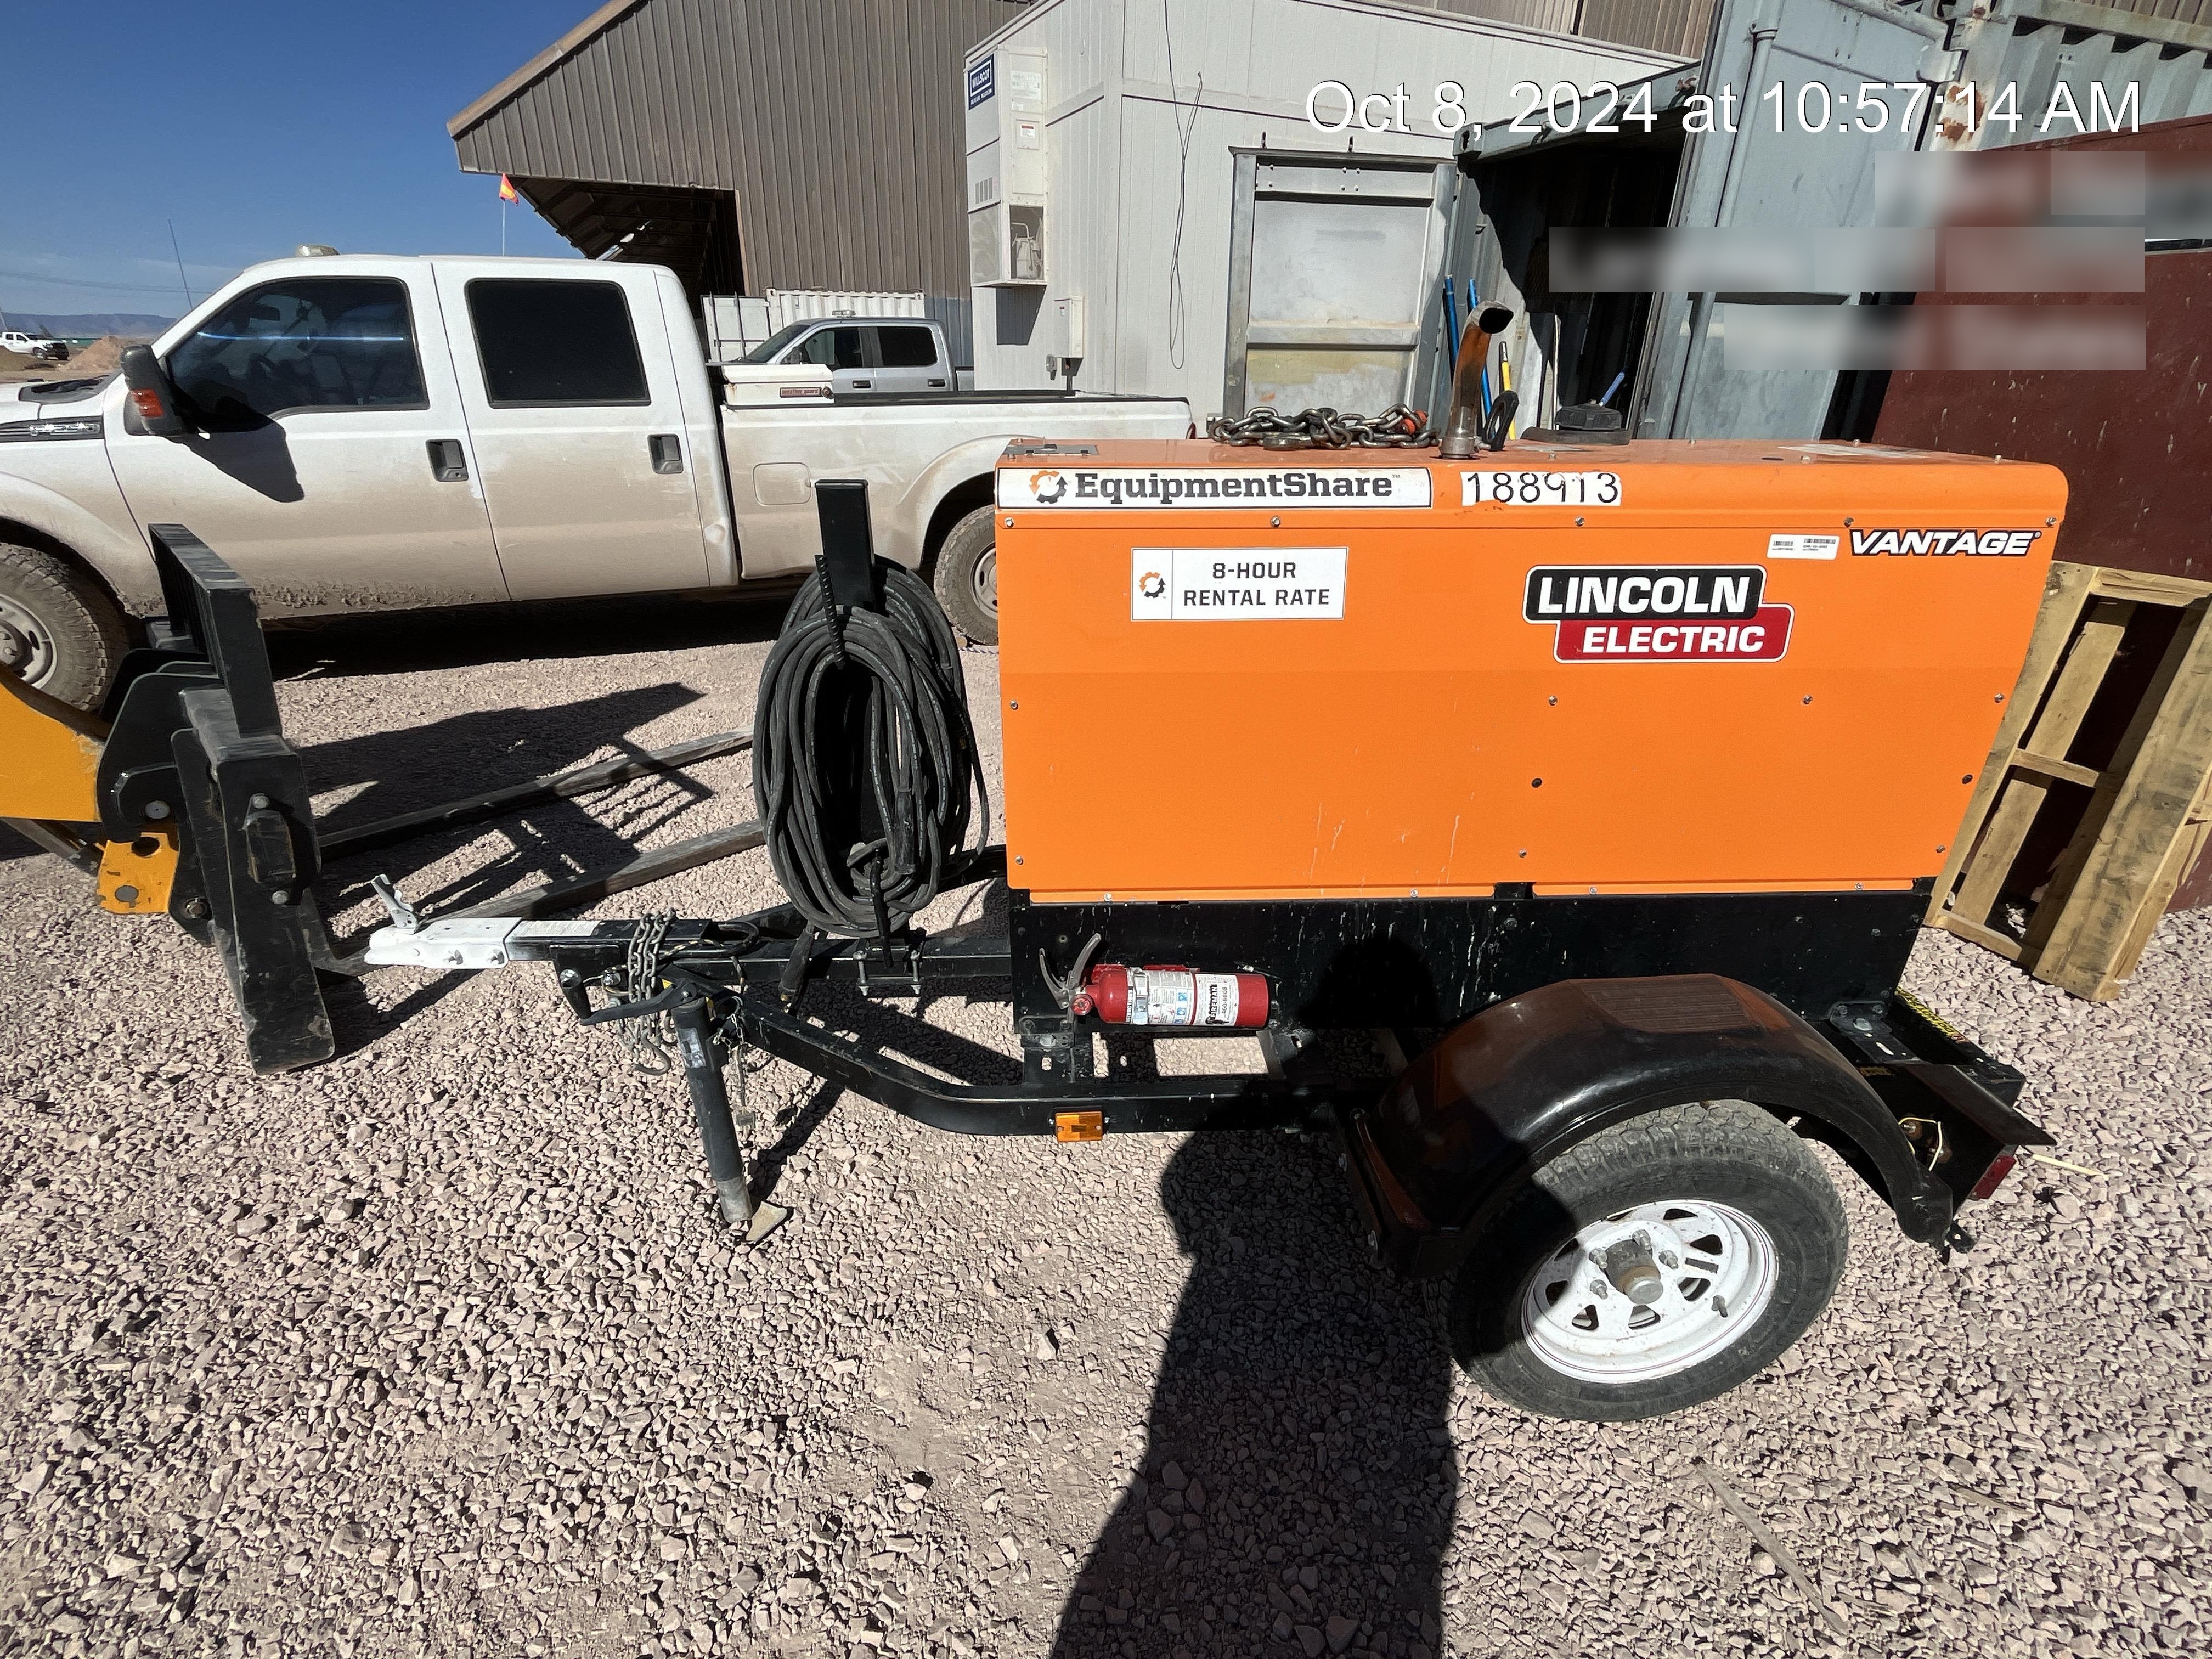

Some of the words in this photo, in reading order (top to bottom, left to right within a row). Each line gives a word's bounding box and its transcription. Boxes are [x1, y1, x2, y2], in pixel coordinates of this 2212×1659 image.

[1075, 472, 1392, 505] EquipmentShare
[1467, 472, 1618, 503] 188913
[1852, 531, 2034, 555] VANTAGE
[1212, 562, 1296, 579] 8-HOUR
[1184, 589, 1266, 606] RENTAL
[1275, 589, 1330, 605] RATE
[1538, 576, 1750, 614] LINCOLN
[1583, 626, 1765, 653] ELECTRIC
